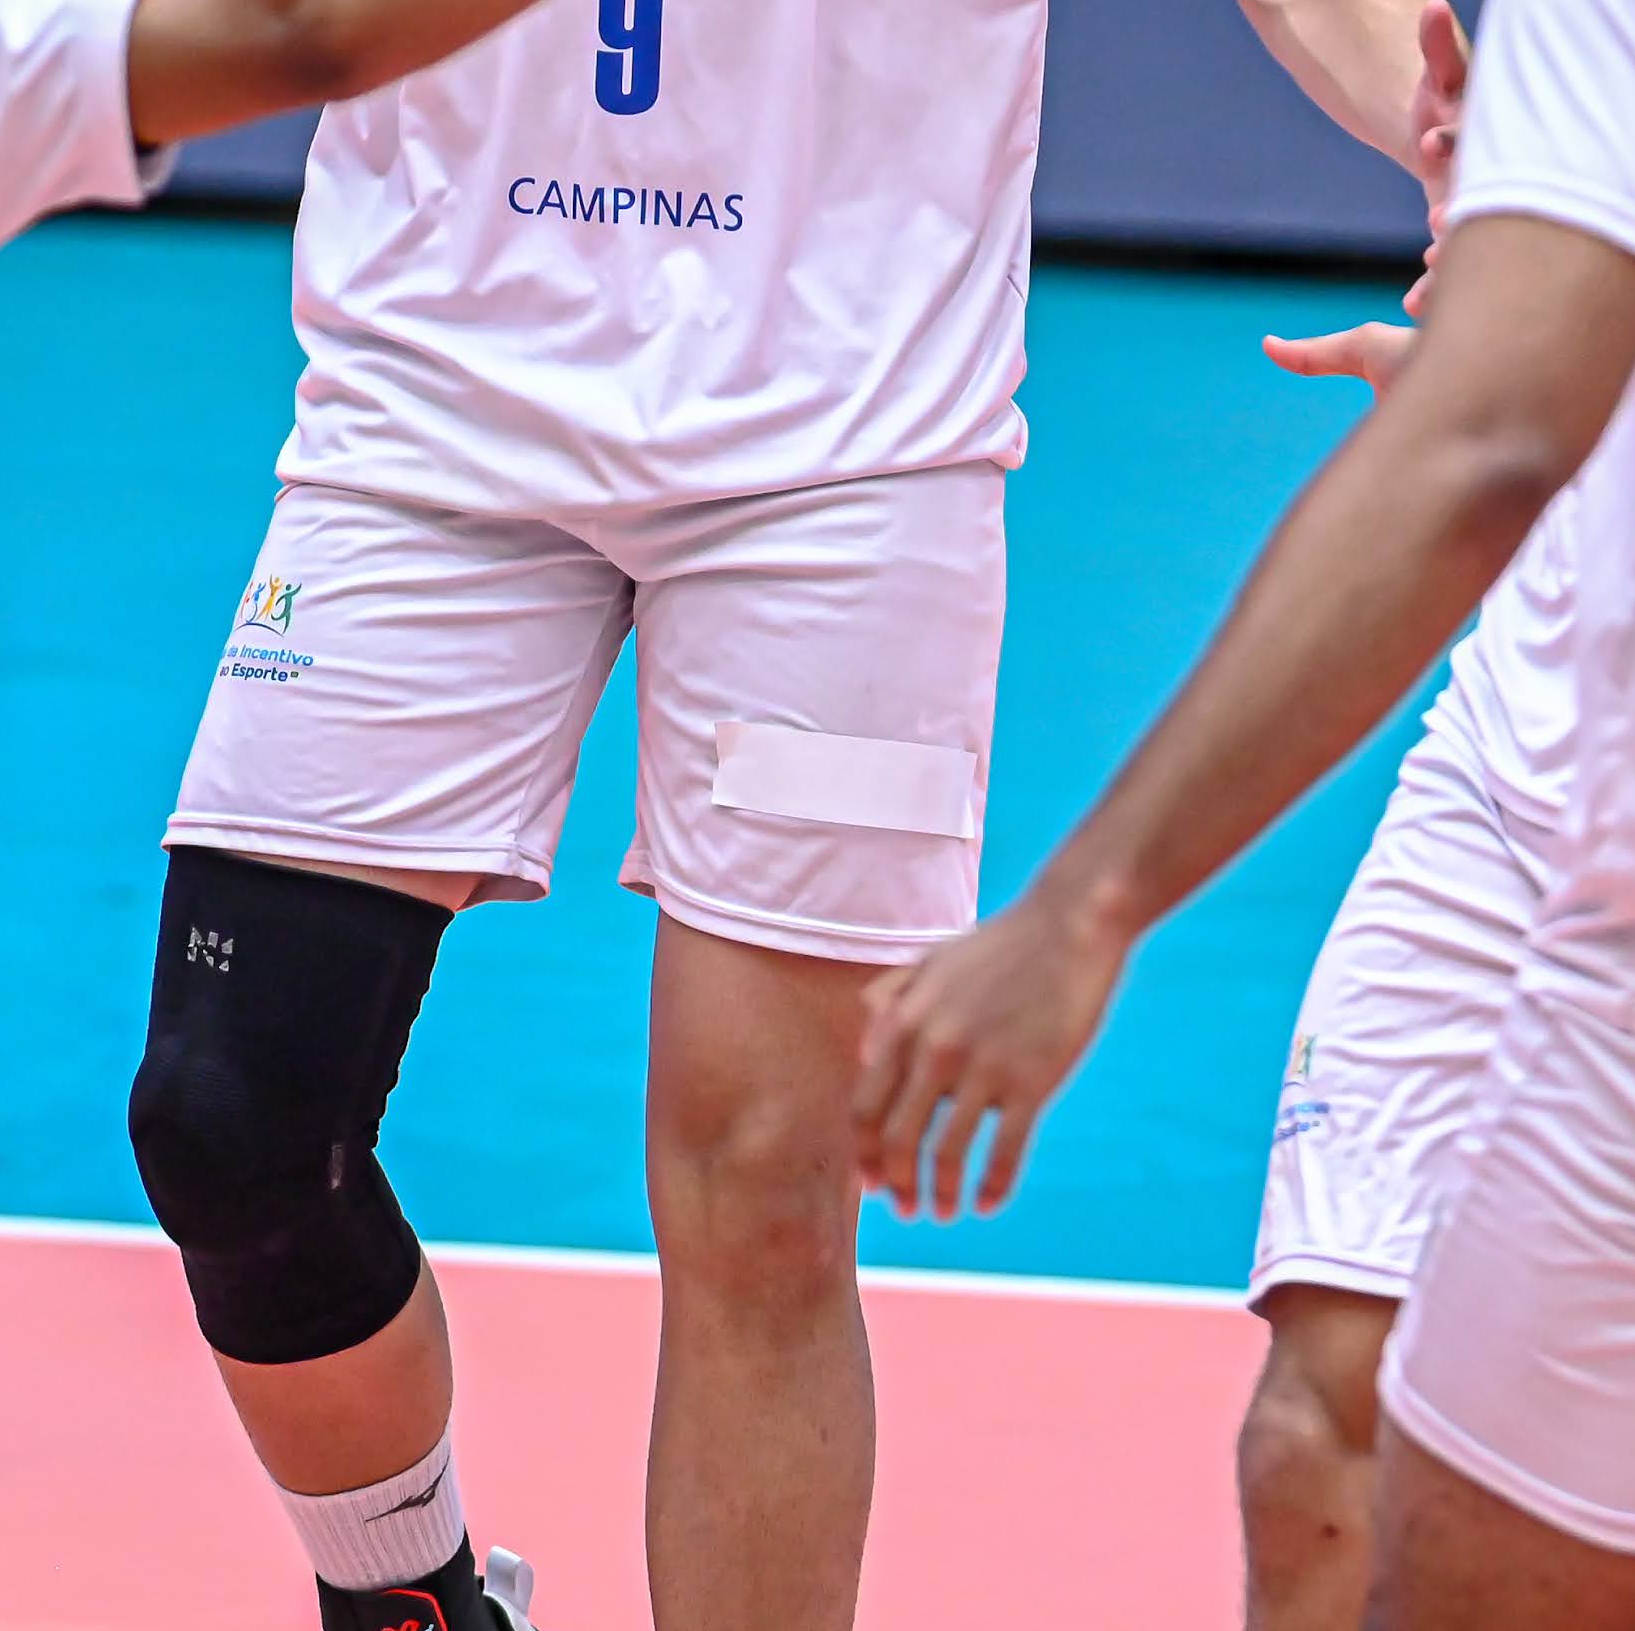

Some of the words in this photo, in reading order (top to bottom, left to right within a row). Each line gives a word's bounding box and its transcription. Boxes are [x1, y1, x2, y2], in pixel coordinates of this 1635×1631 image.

[507, 176, 744, 232] CAMPINAS
[240, 644, 314, 667] Incentivo
[231, 663, 289, 682] Esporte
